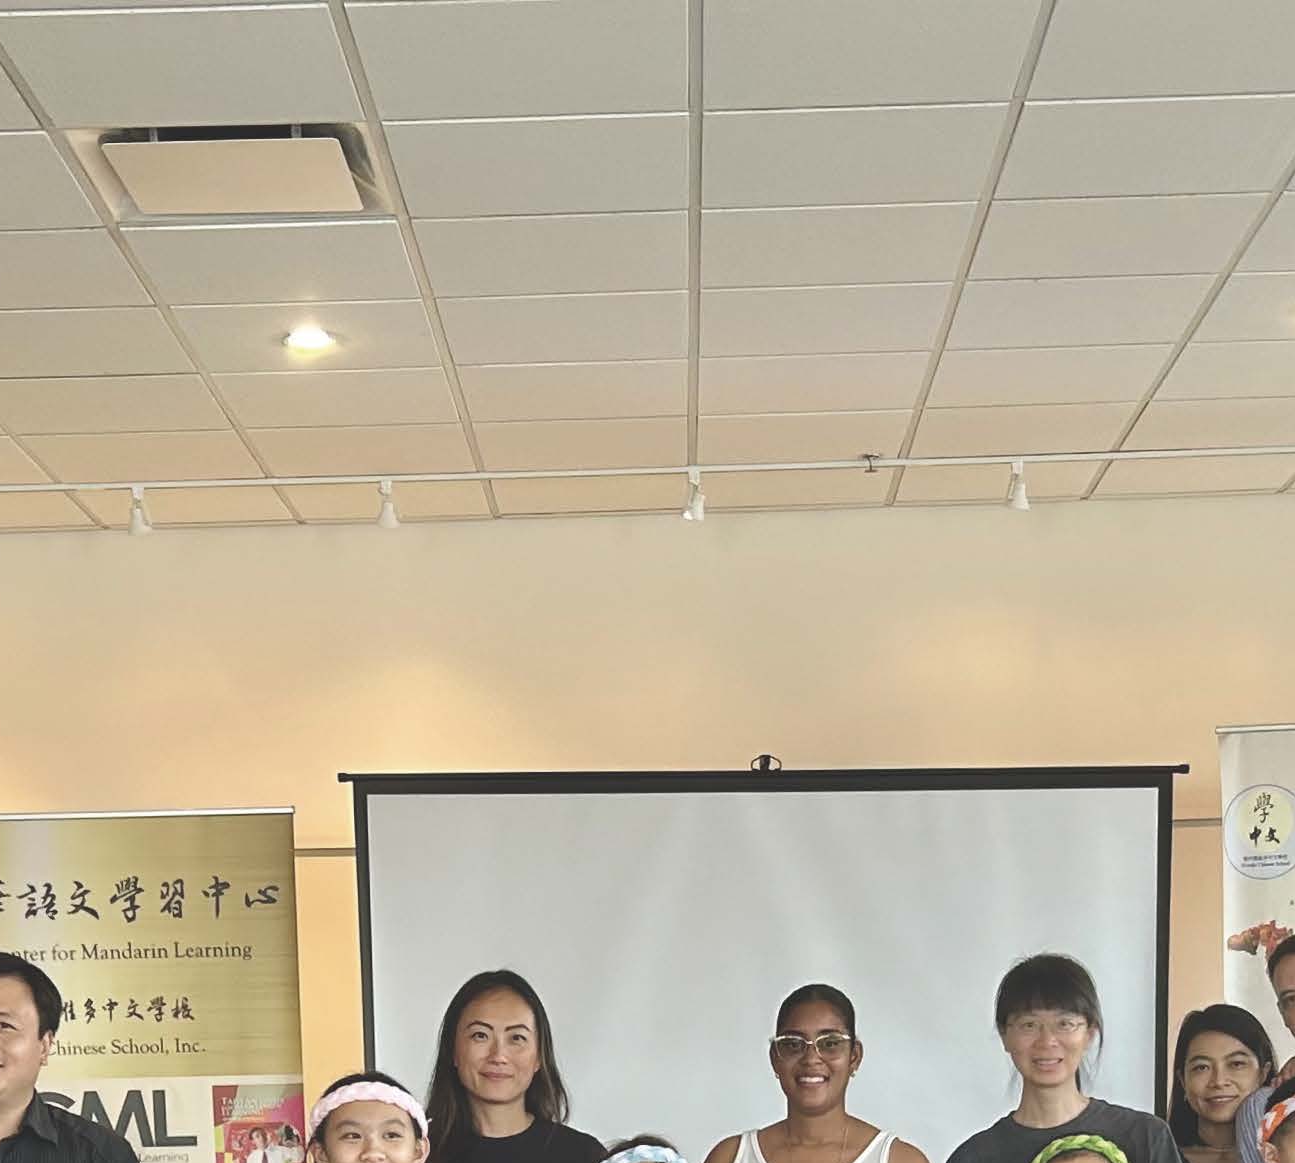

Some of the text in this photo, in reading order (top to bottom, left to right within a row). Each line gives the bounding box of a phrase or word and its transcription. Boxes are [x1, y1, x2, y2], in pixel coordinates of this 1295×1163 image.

[52, 942, 76, 961] for
[80, 941, 168, 961] Mandarin
[174, 940, 253, 960] Learning
[111, 1037, 170, 1056] School,
[175, 1037, 206, 1053] Inc.
